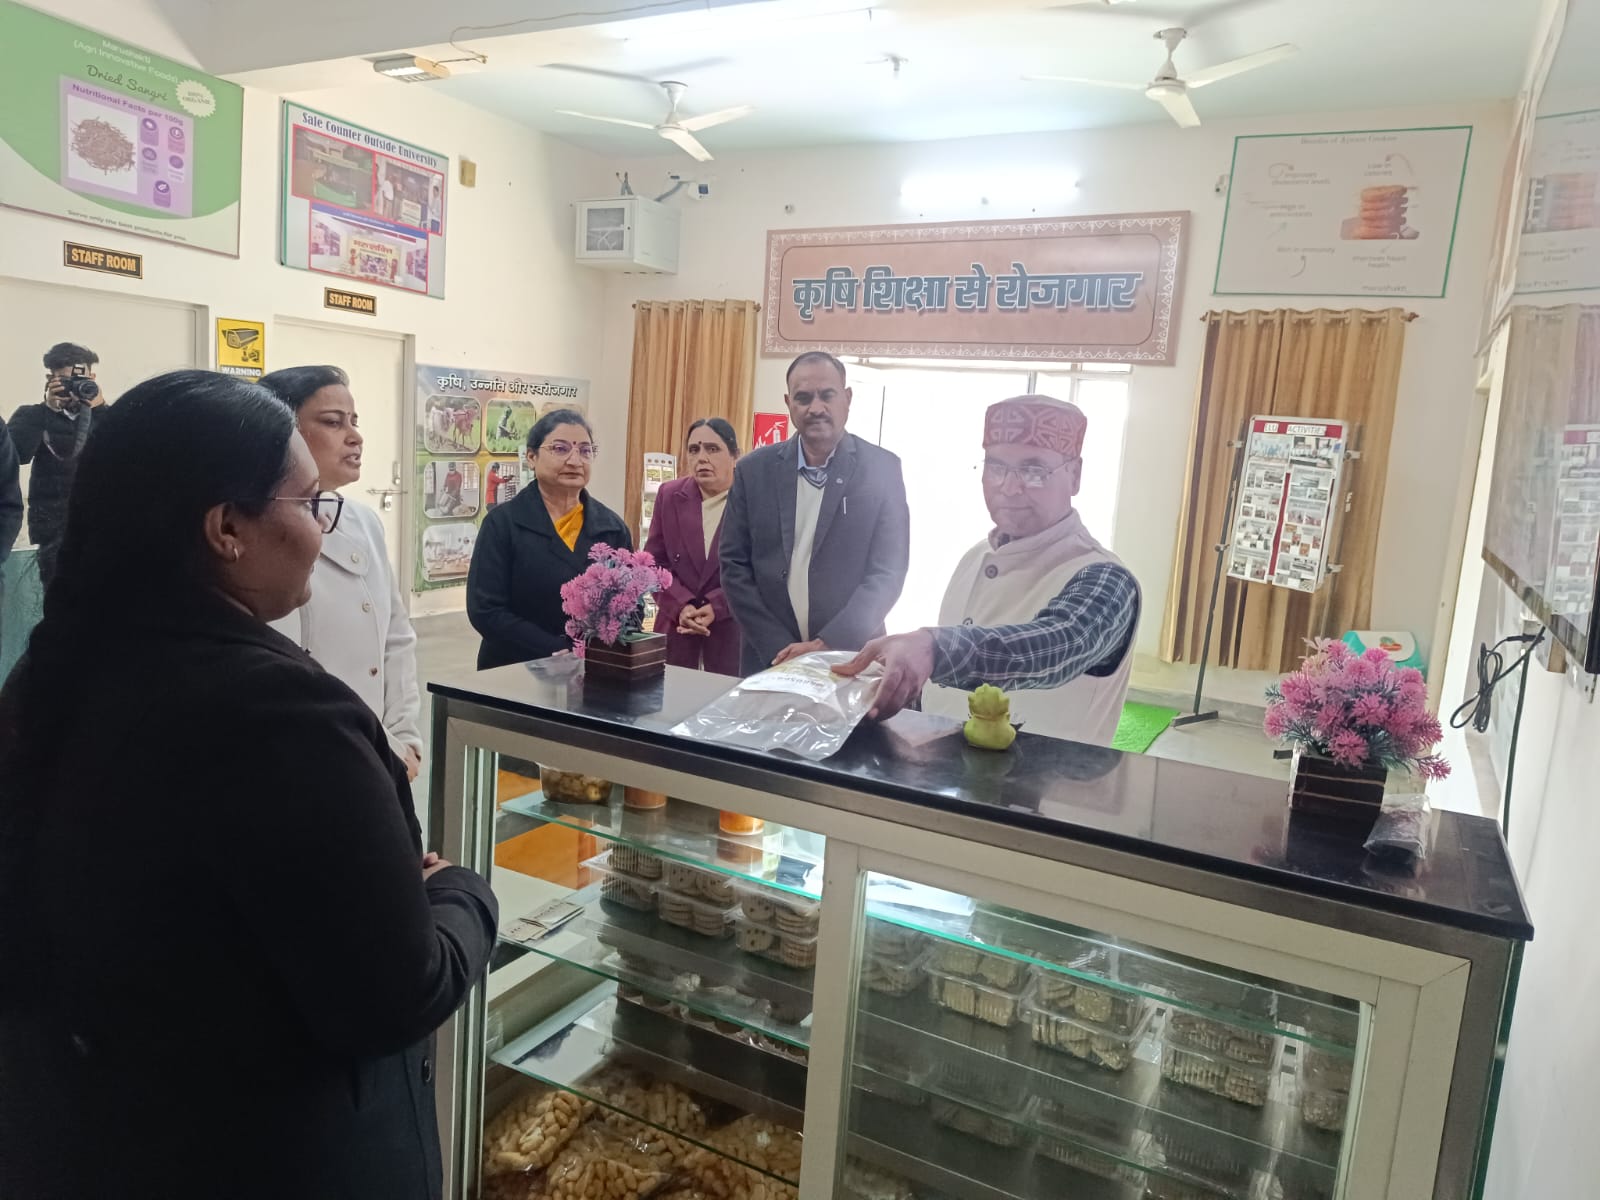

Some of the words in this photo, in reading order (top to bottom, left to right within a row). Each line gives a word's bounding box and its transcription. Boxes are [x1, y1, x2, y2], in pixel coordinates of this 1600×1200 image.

[86, 64, 123, 86] Dried
[72, 83, 121, 106] Nutritional
[122, 100, 146, 114] Facts
[148, 110, 163, 120] per
[302, 111, 323, 129] Sale
[325, 119, 362, 142] Counter
[364, 132, 398, 154] Outside
[398, 144, 438, 168] University
[71, 247, 104, 266] STAFF
[106, 254, 137, 272] ROOM
[329, 292, 352, 307] STAFF
[352, 296, 373, 312] ROOM
[792, 265, 860, 321] कृषि
[862, 264, 952, 313] शिक्षा
[953, 262, 993, 310] से
[995, 261, 1144, 310] रोजगार
[222, 366, 262, 377] WARNING
[508, 377, 529, 395] और
[529, 382, 578, 398] स्वरोजगार
[1287, 425, 1325, 435] ACTIVITIES
